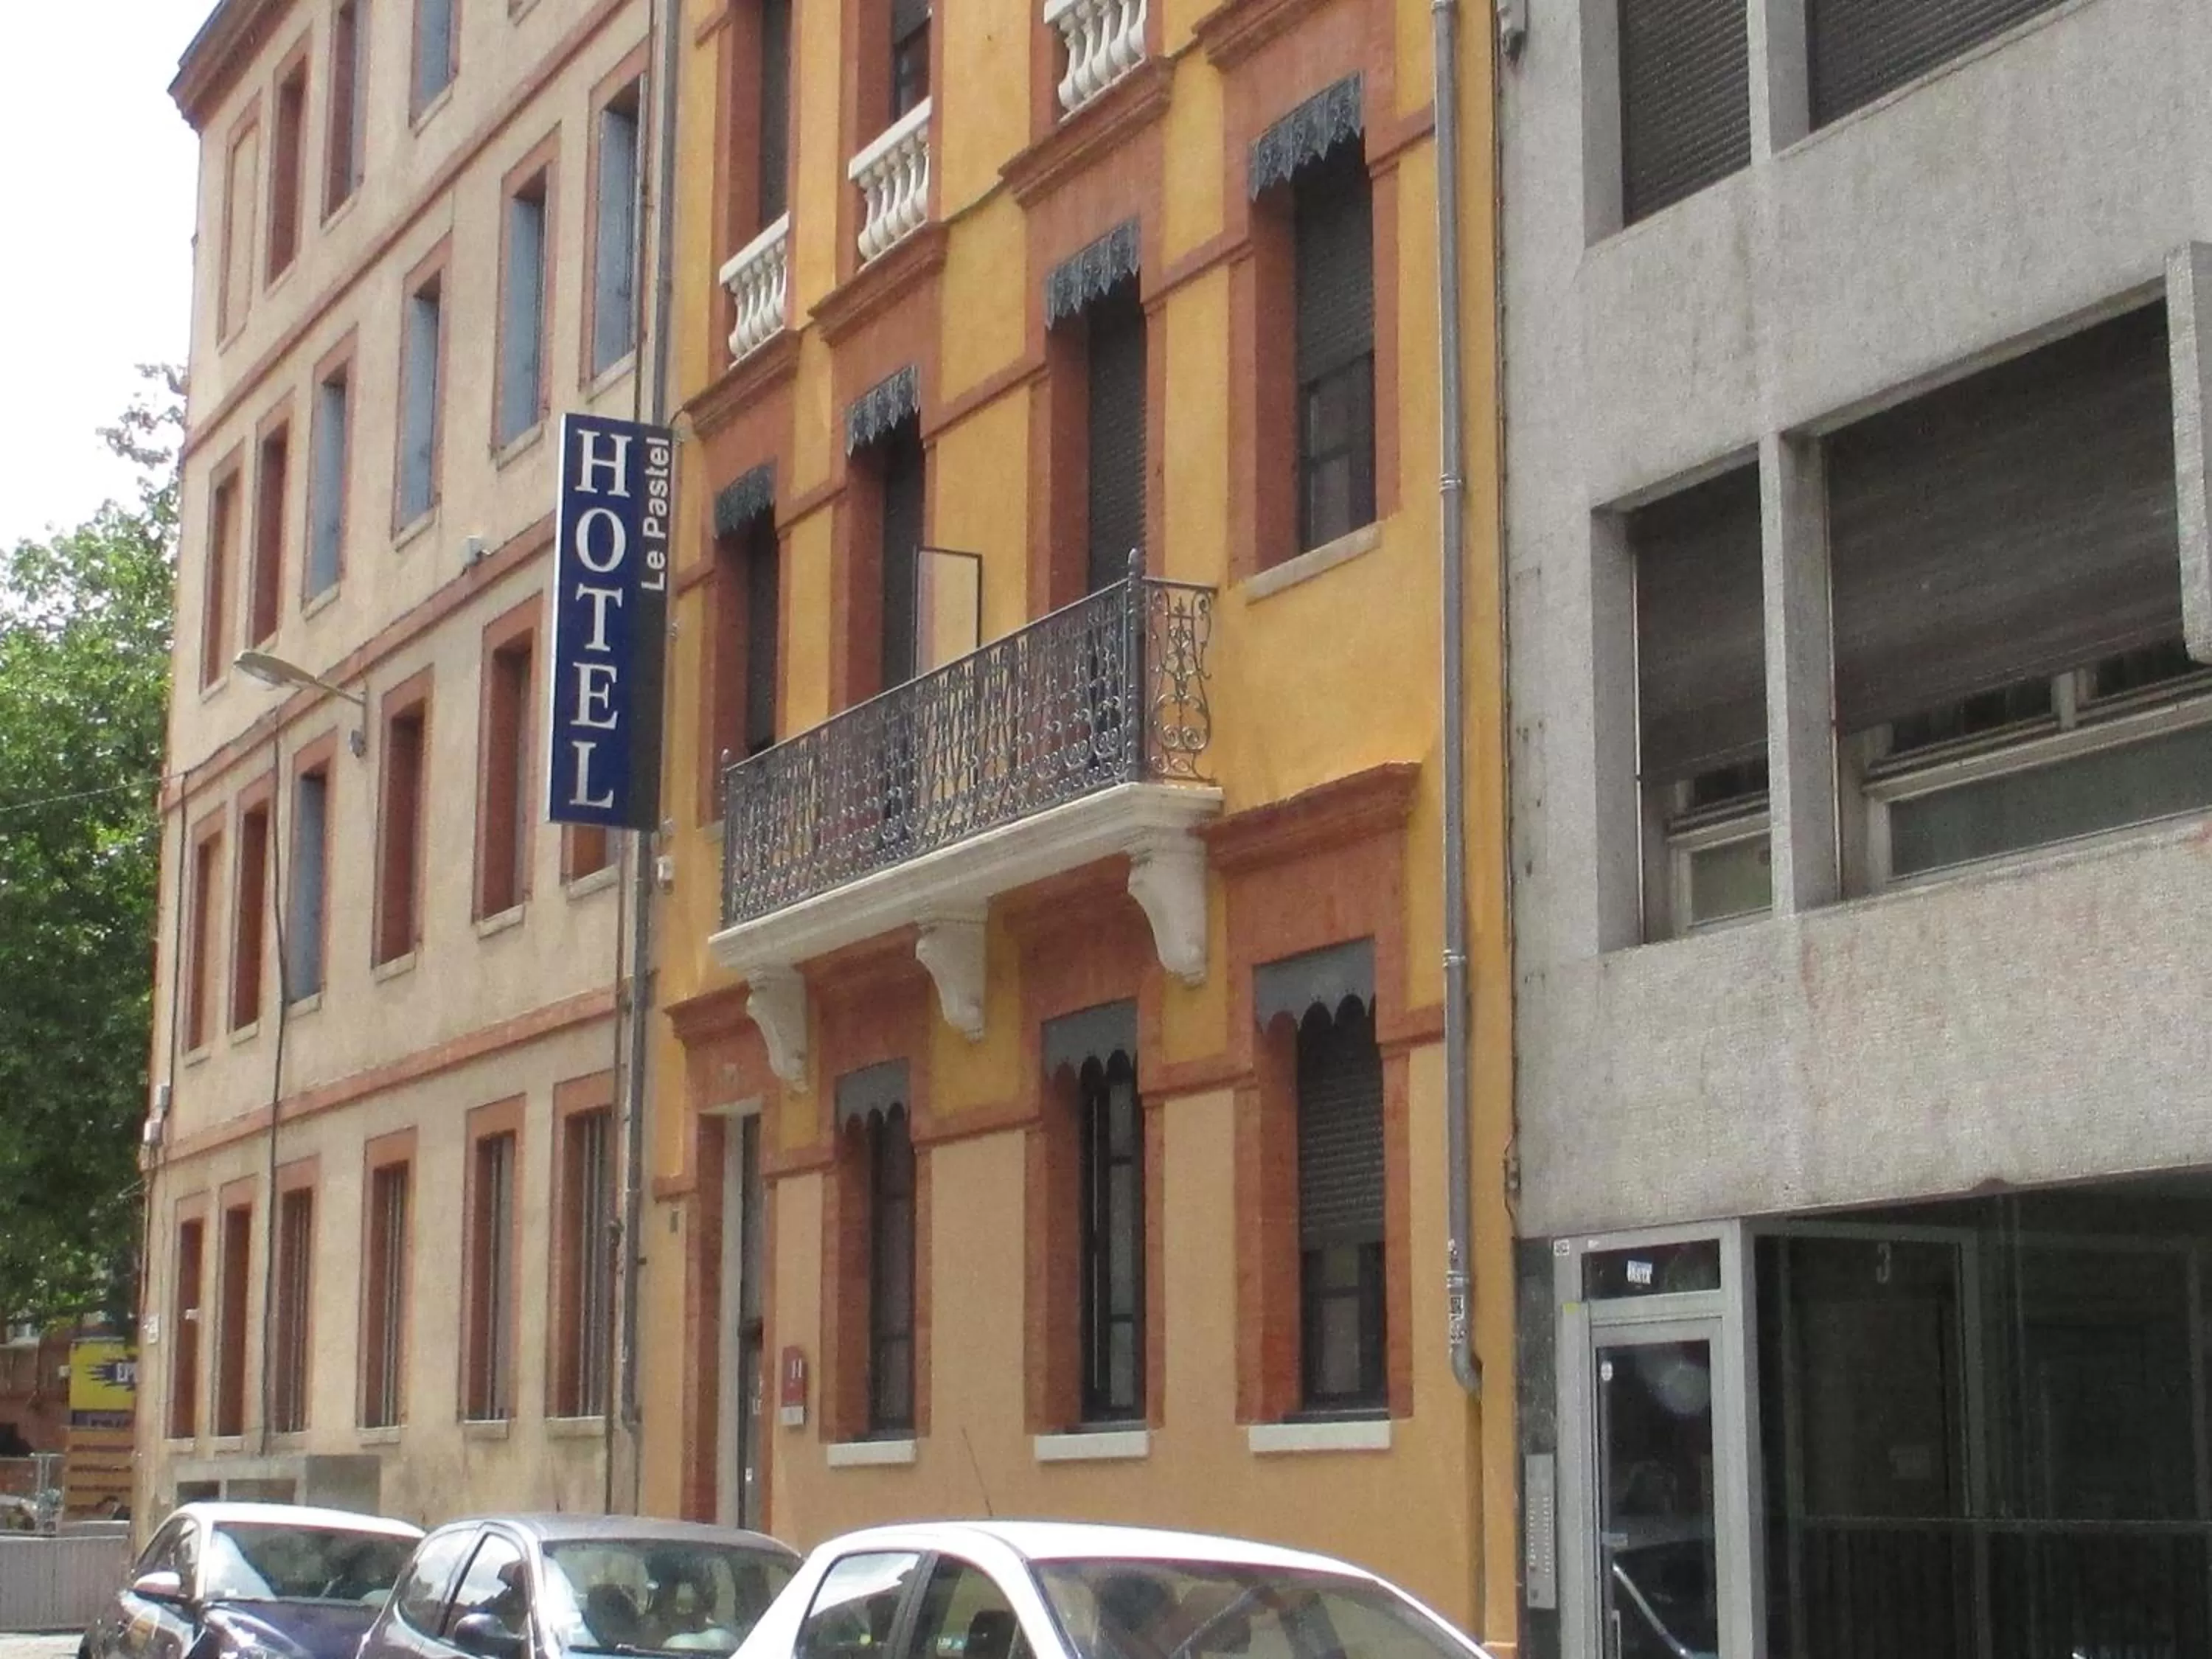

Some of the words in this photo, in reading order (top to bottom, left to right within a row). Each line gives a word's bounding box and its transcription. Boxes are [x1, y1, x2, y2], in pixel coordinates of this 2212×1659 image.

[642, 437, 669, 539] Pastel
[569, 428, 633, 809] HOTEL
[641, 551, 665, 591] Le
